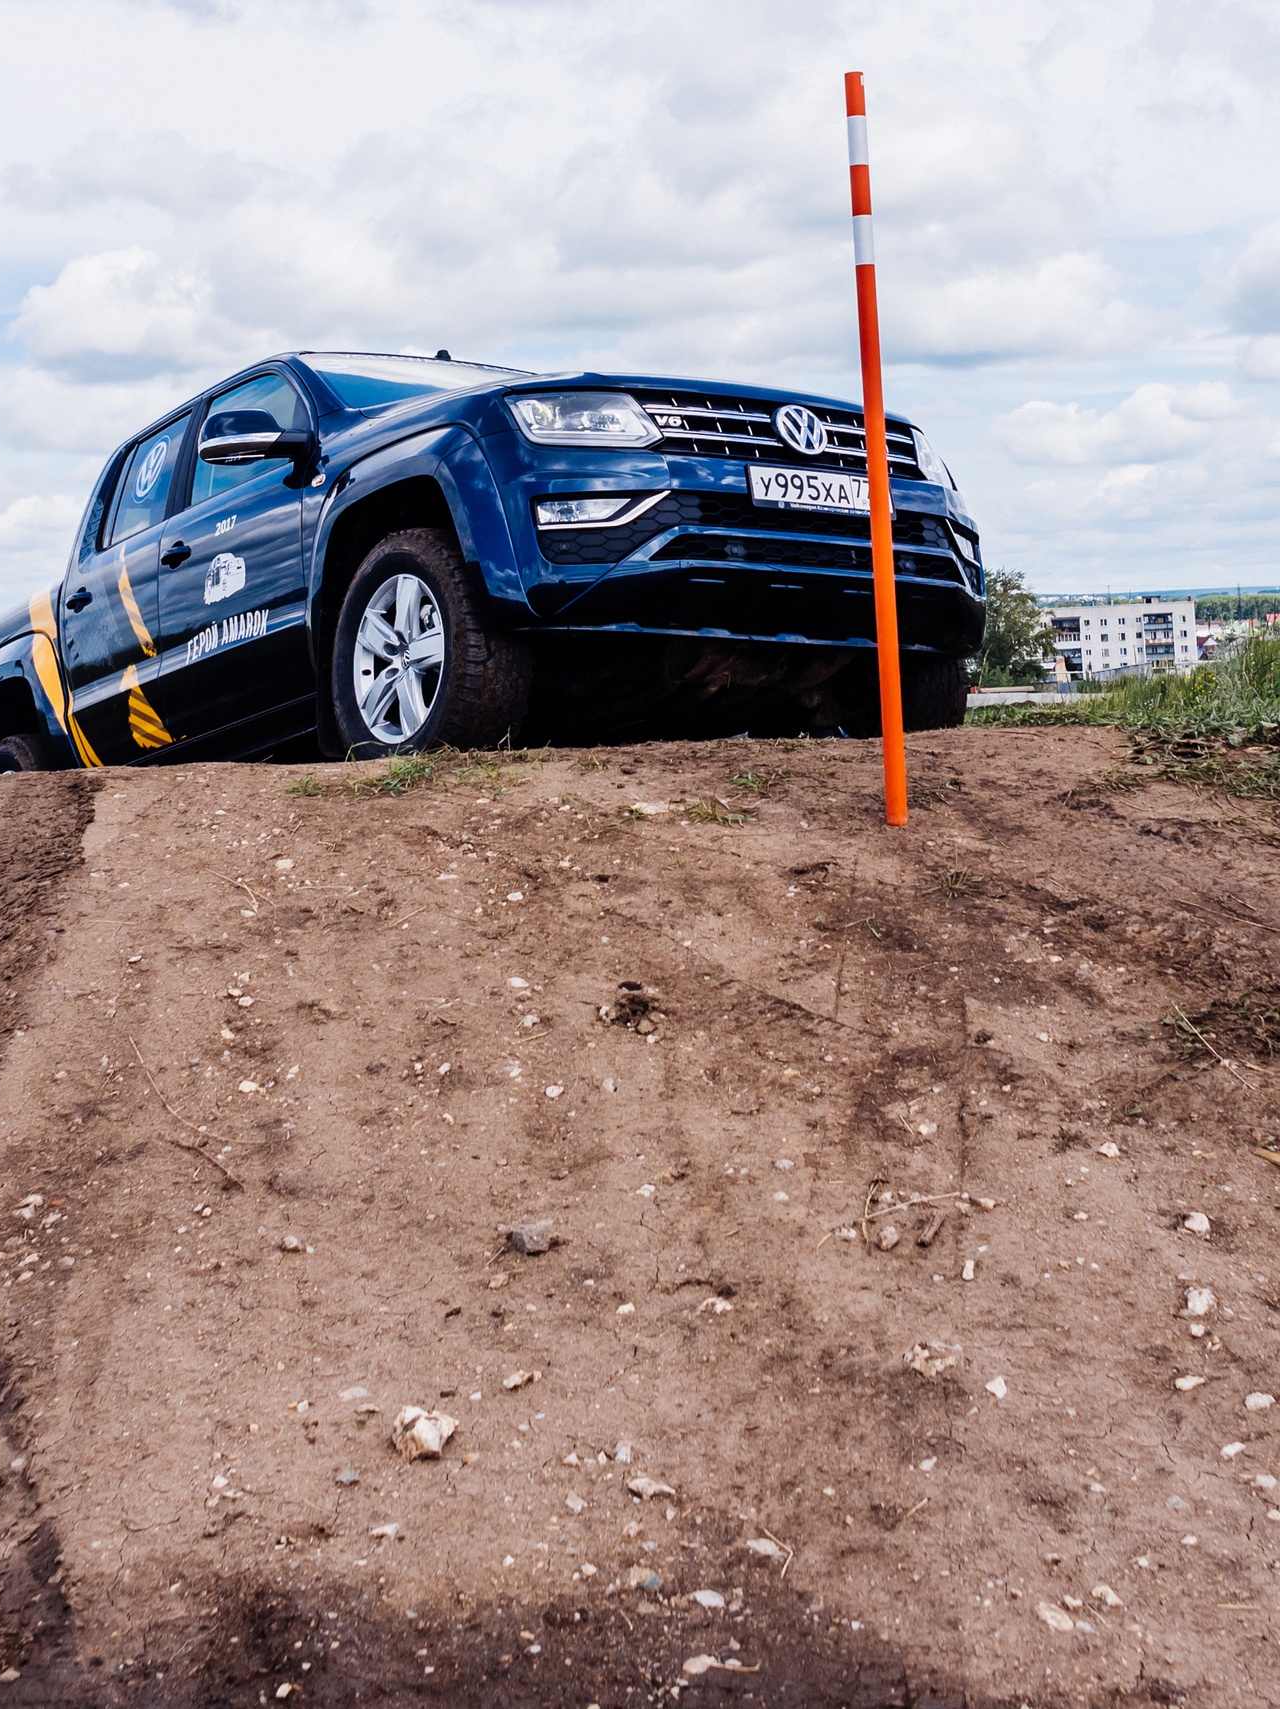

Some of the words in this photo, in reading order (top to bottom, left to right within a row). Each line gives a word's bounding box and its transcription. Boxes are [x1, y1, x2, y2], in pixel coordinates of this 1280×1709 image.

[654, 415, 682, 426] V6
[760, 472, 851, 505] У995ХА
[852, 478, 870, 500] 77
[214, 514, 238, 537] 2017
[185, 620, 219, 666] ГЕРОЙ
[221, 608, 270, 646] AMAROK
